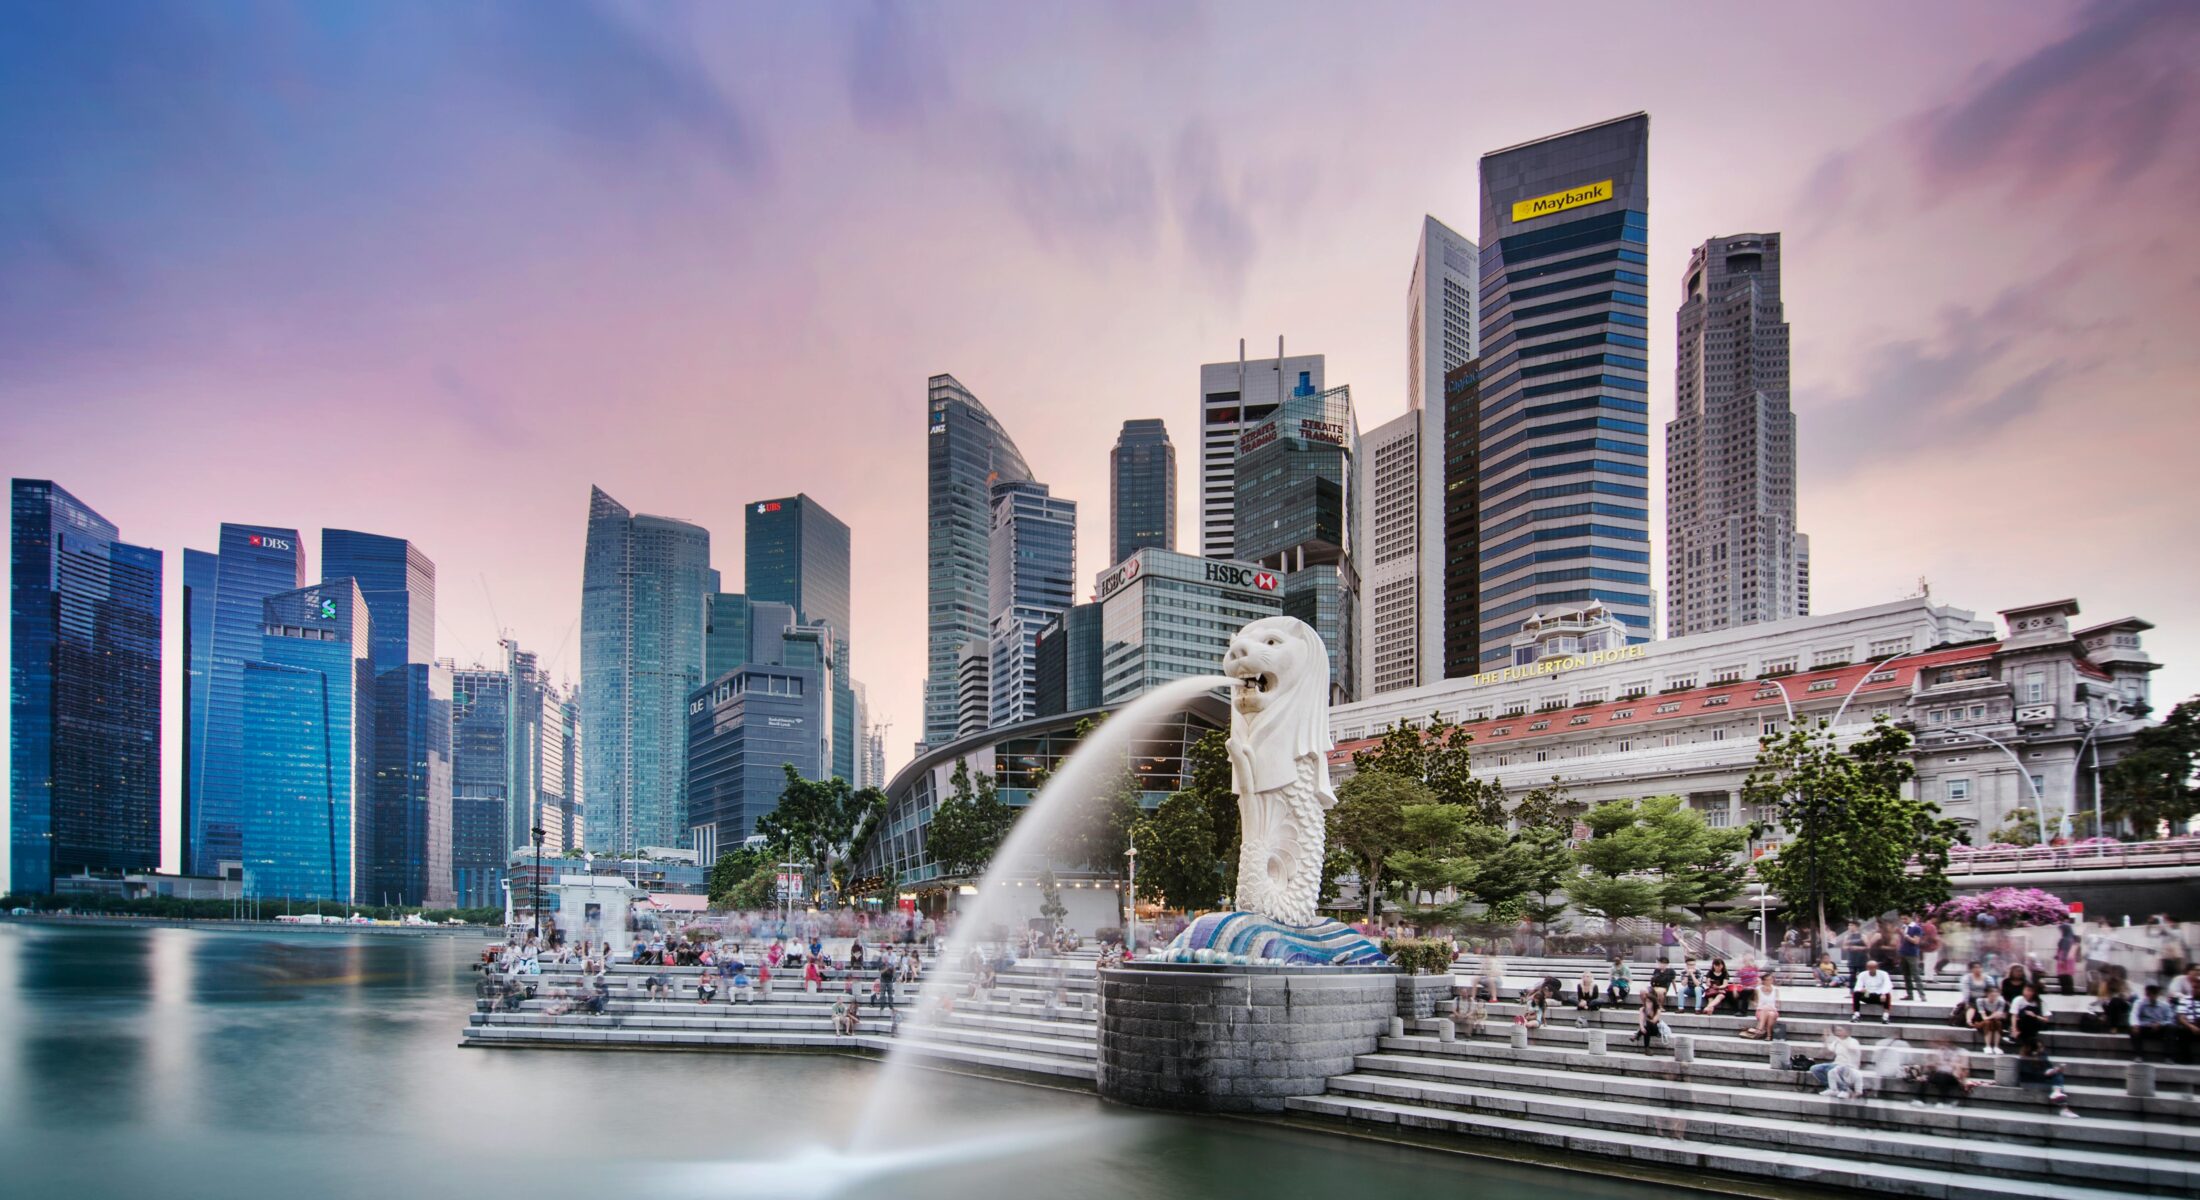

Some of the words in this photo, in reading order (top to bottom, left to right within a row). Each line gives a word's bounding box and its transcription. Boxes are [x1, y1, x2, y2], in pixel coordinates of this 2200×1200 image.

[1533, 186, 1602, 212] Maybank
[1241, 421, 1276, 445] STRAITS
[1299, 428, 1343, 444] TRADING
[1302, 419, 1343, 433] STRAITS
[766, 502, 781, 512] UBS
[262, 536, 289, 550] DBS
[1102, 567, 1125, 598] HSBC
[1205, 562, 1252, 587] HSBC
[1473, 673, 1499, 686] THE
[1503, 656, 1586, 681] FULLERTON
[1592, 646, 1646, 665] HOTEL
